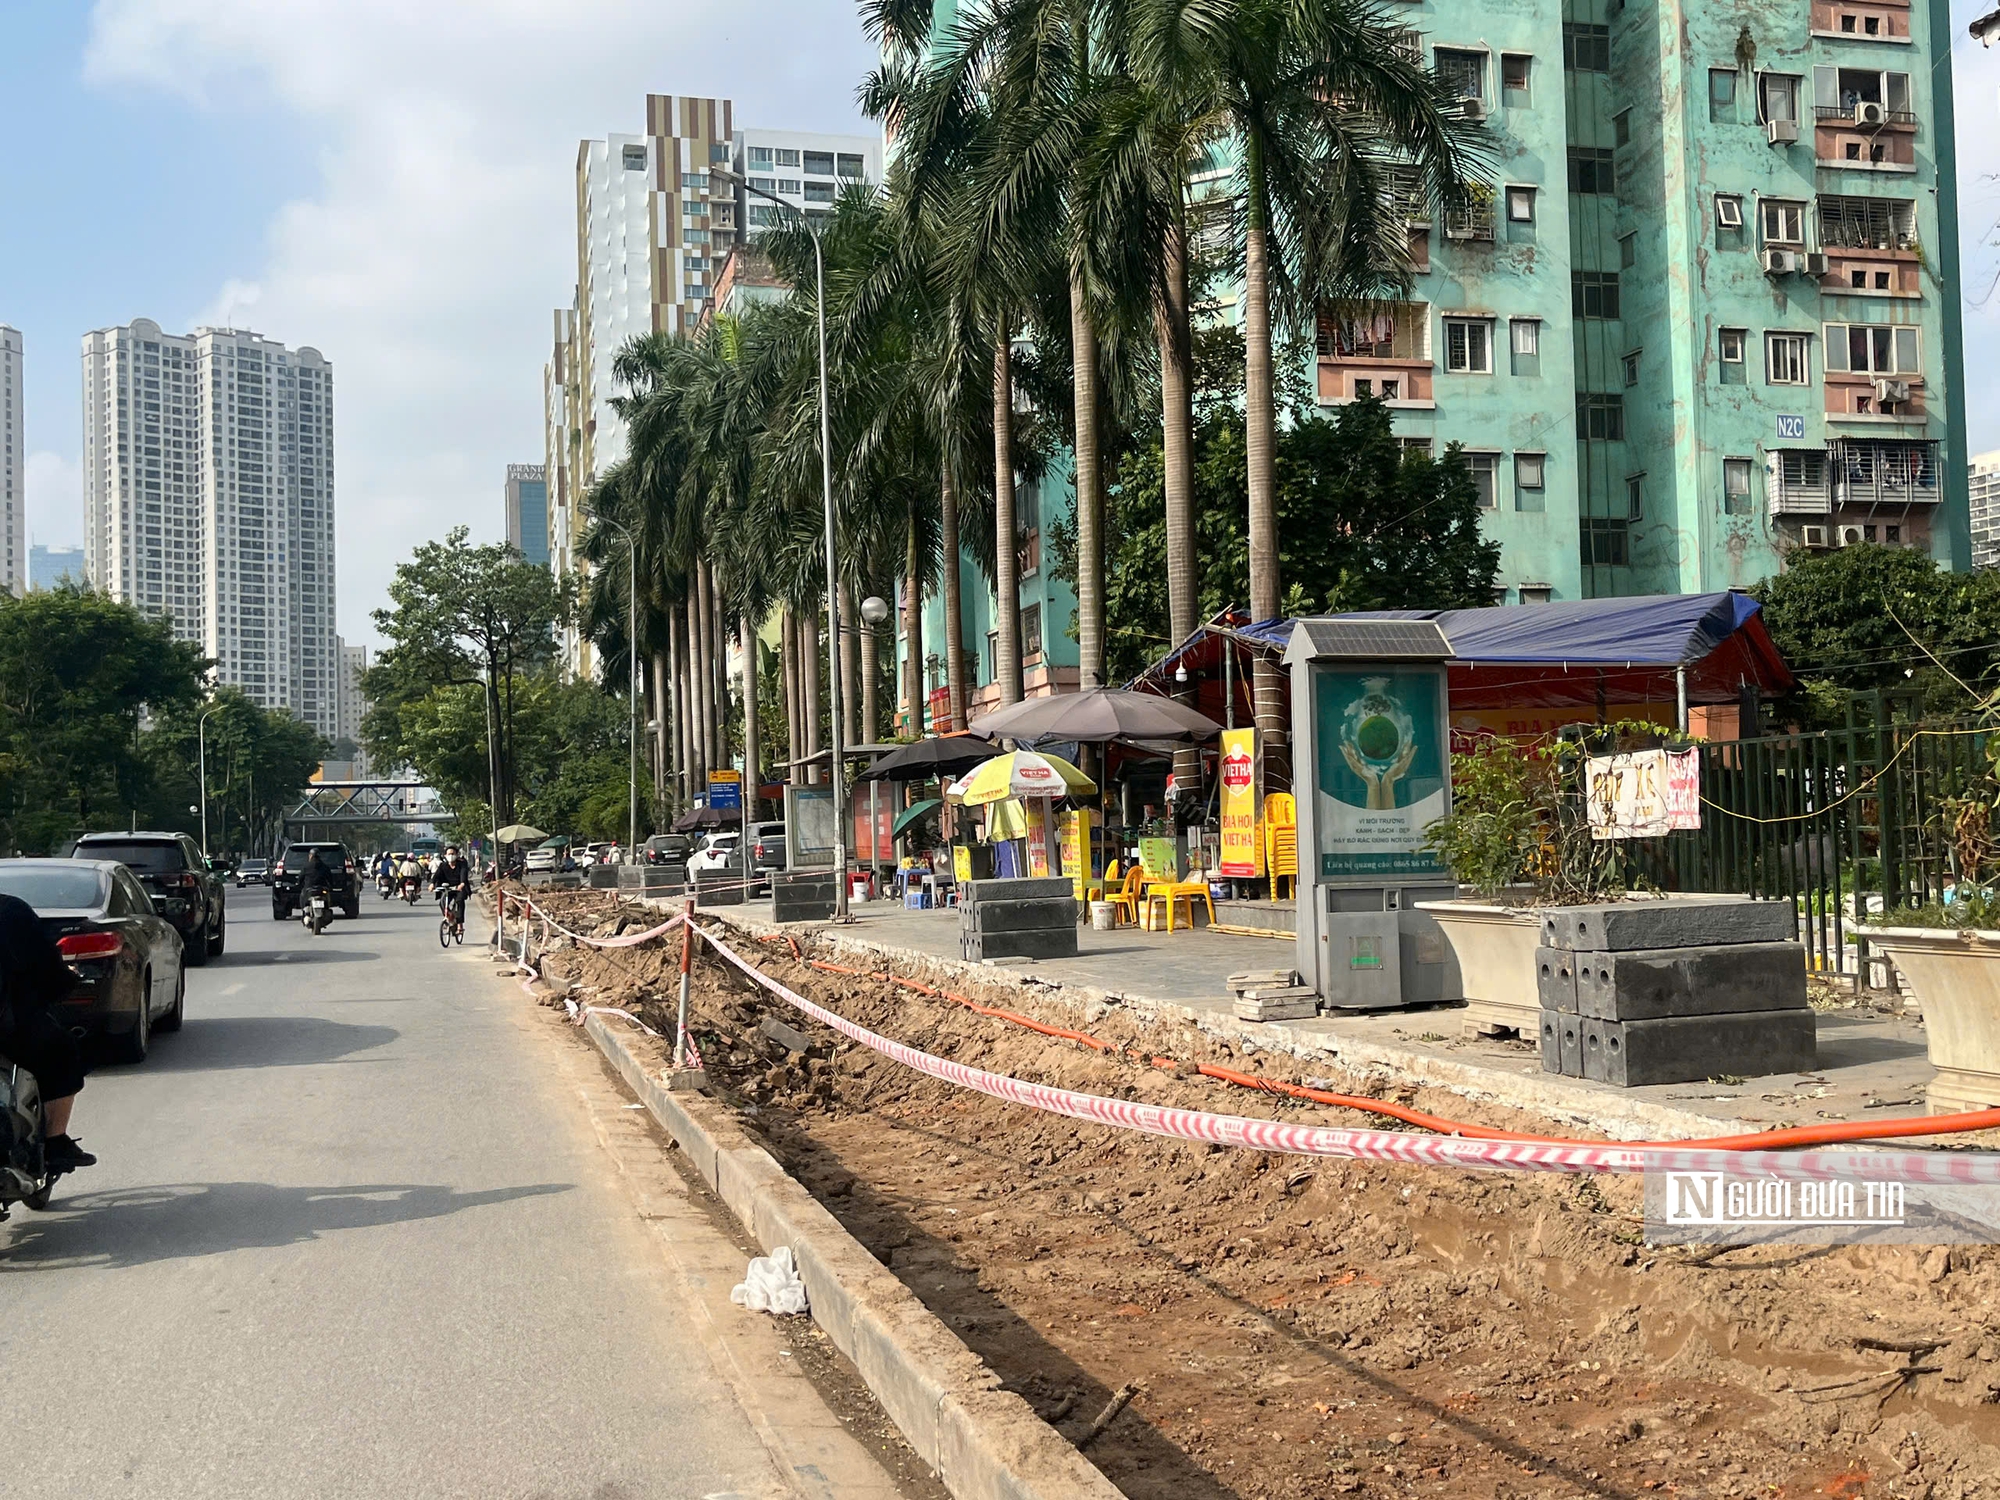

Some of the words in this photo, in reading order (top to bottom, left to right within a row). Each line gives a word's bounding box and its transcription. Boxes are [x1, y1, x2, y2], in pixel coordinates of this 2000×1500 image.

[1778, 417, 1803, 437] N2C
[511, 472, 542, 480] PLAZA
[1223, 814, 1236, 828] BIA
[1241, 833, 1252, 846] HA
